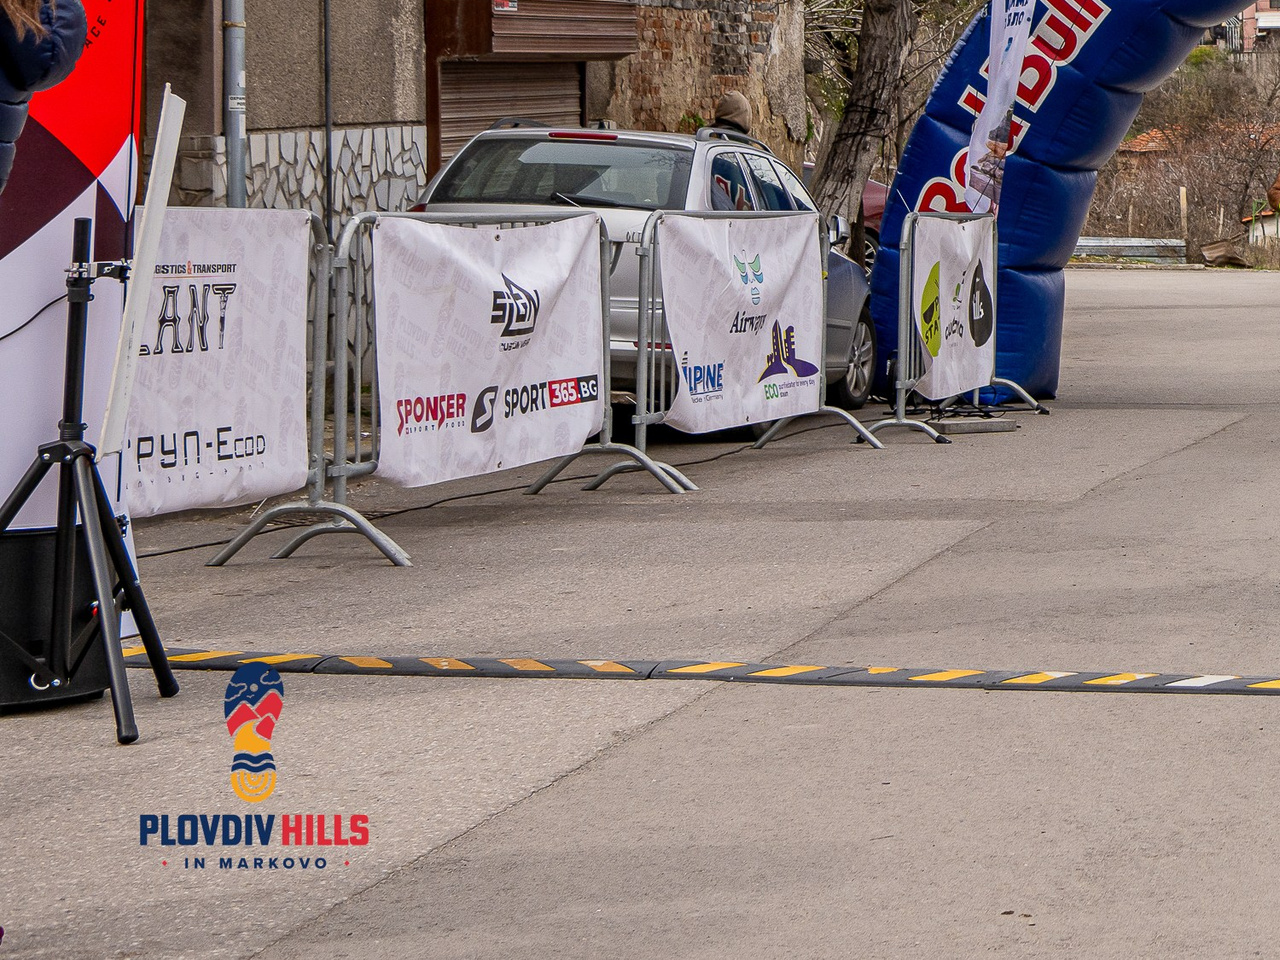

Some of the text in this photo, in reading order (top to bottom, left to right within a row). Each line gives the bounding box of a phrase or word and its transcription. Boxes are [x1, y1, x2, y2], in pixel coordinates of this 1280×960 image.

[193, 263, 237, 274] TRANSPORT
[763, 383, 779, 400] ECO
[396, 392, 467, 438] SPONSER
